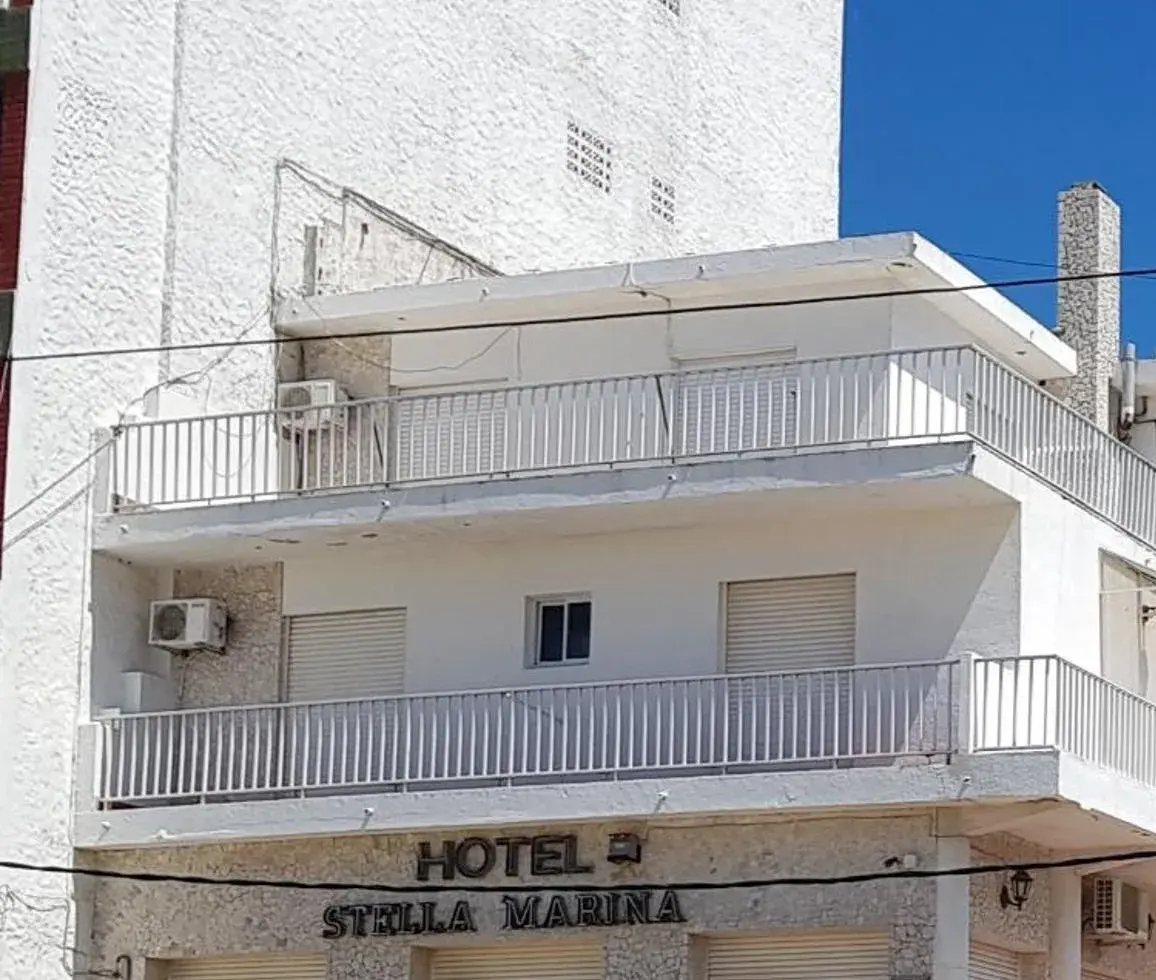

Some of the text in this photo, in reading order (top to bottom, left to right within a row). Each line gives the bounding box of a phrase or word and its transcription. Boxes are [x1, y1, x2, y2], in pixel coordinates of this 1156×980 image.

[416, 834, 594, 881] HOTEL
[322, 890, 688, 939] STELLA MARINA
